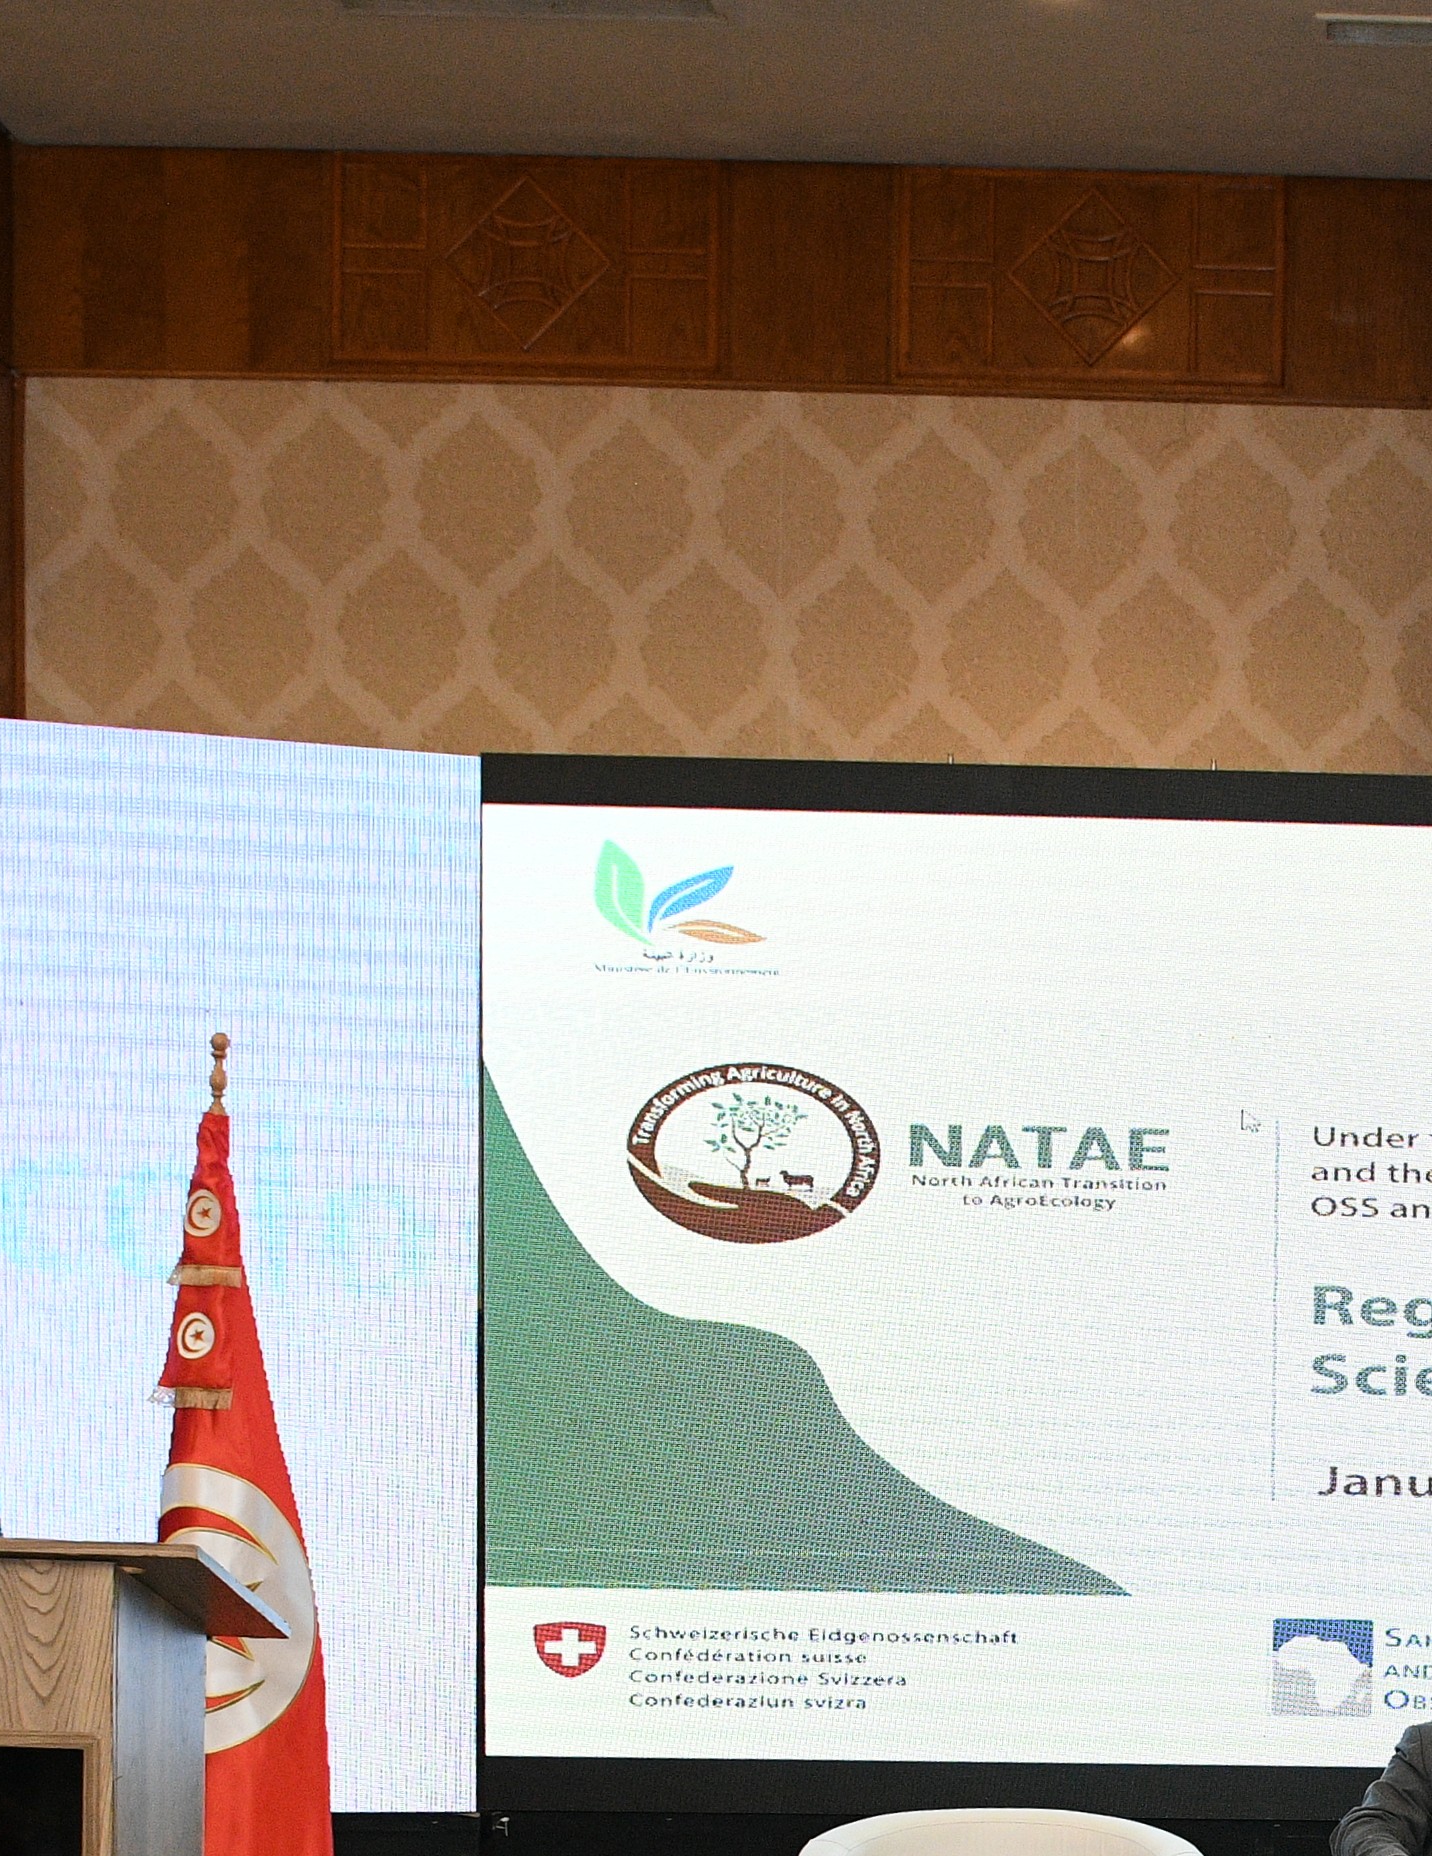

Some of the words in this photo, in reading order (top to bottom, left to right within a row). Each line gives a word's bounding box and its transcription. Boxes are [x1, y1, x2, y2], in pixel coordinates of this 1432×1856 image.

[726, 1065, 834, 1100] Agriculture
[909, 1123, 1170, 1171] NATAE
[1313, 1126, 1419, 1151] Under
[912, 1174, 972, 1188] North
[979, 1175, 1054, 1190] African
[1061, 1177, 1167, 1191] Transition
[1312, 1162, 1375, 1185] and
[963, 1195, 983, 1206] to
[990, 1195, 1116, 1211] AgroEcology
[1312, 1197, 1379, 1218] OSS
[629, 1625, 799, 1643] Schweizerische
[629, 1647, 793, 1664] Confédération
[629, 1669, 809, 1687] Confederazione
[818, 1671, 907, 1687] Svizzera
[804, 1695, 867, 1711] svizra
